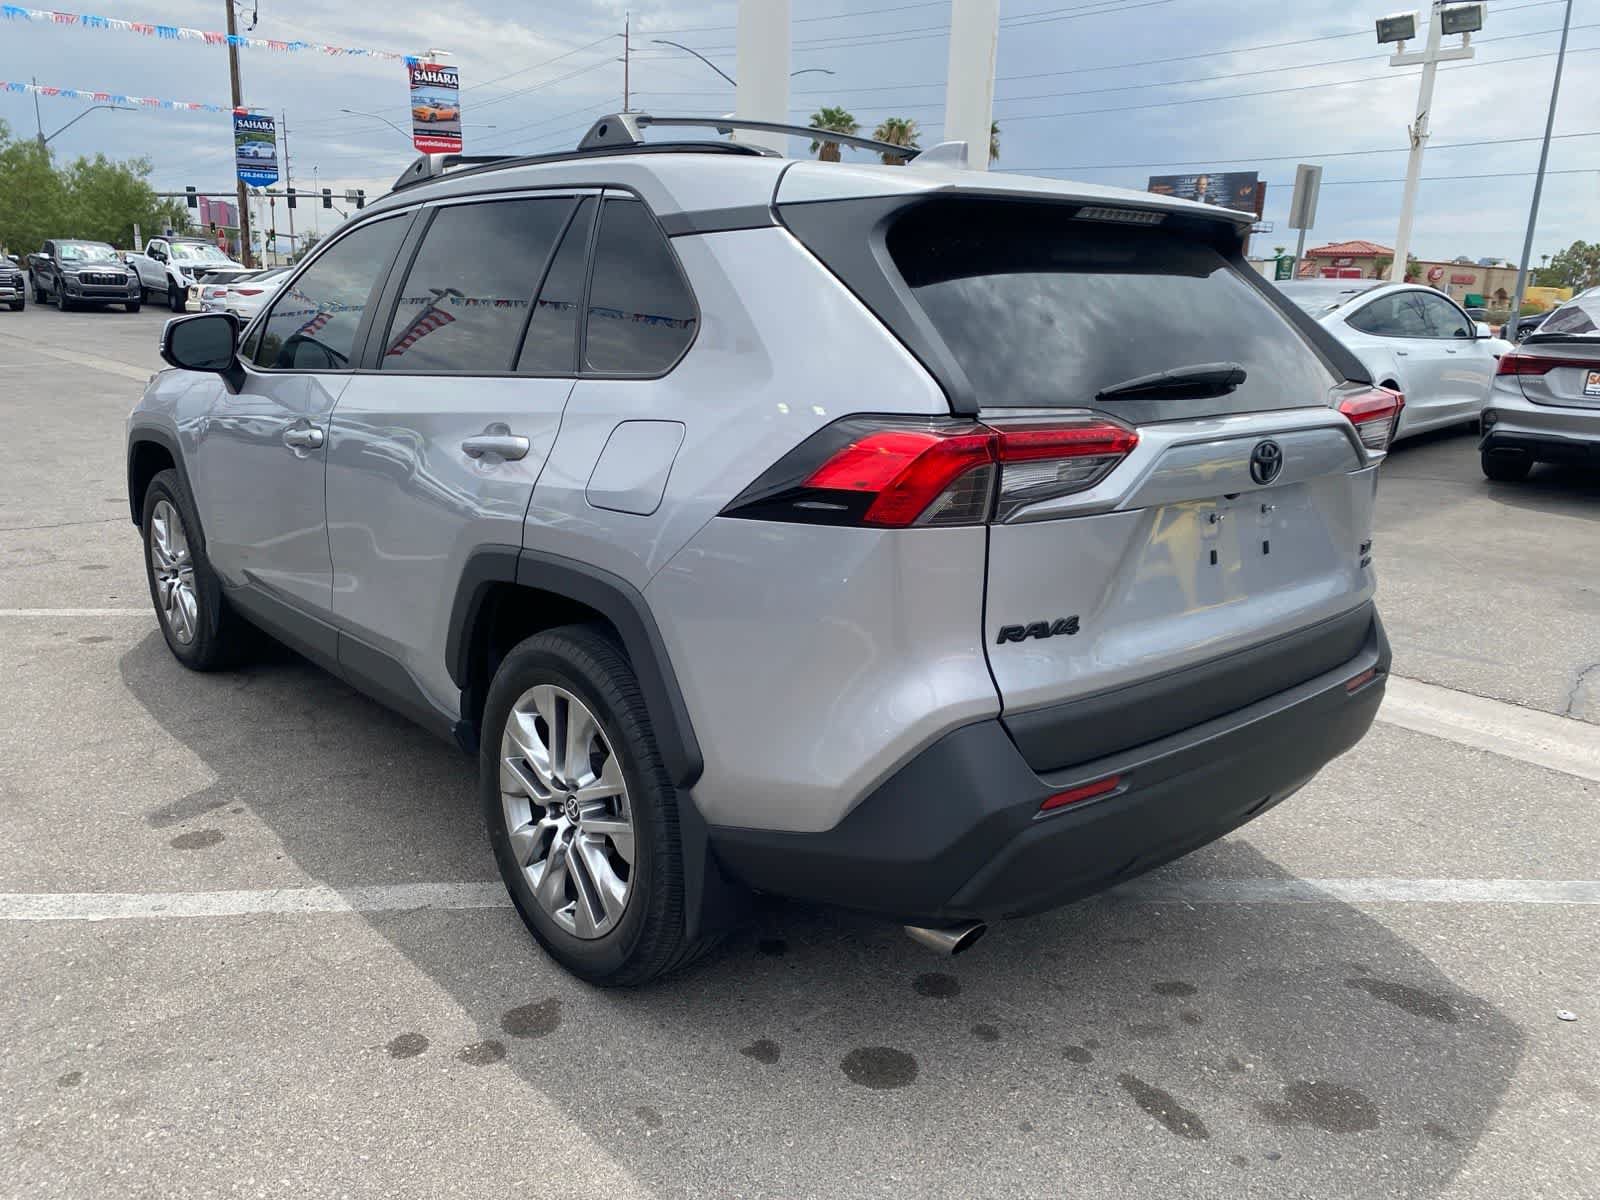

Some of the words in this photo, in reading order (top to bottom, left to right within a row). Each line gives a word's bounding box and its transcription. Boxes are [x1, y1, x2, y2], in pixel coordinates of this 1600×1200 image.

[414, 70, 458, 85] SAHARA
[238, 119, 275, 130] SAHARA
[996, 615, 1080, 645] RAV4
